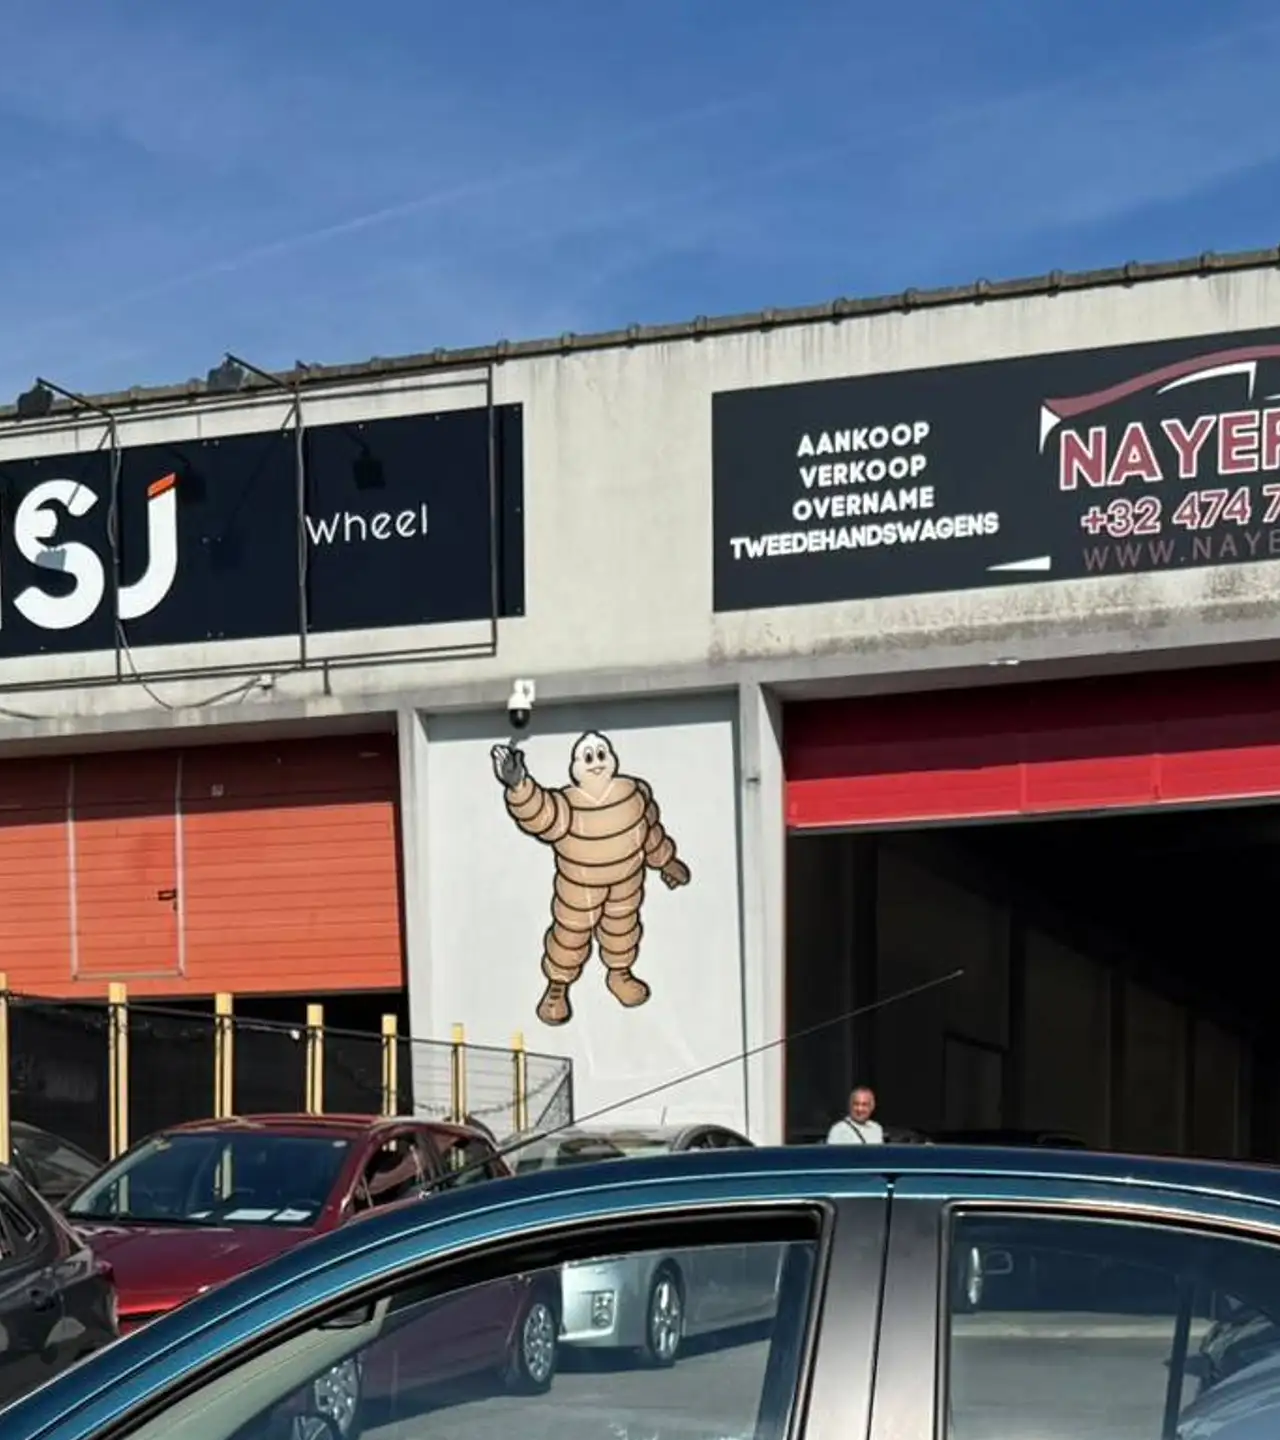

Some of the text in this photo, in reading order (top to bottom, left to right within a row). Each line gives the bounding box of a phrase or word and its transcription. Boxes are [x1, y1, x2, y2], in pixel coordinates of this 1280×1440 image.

[796, 420, 930, 458] AANKOOP
[798, 454, 927, 489] VERKOOP
[791, 485, 935, 521] OVERNAME
[1080, 496, 1161, 538] +32
[1172, 486, 1250, 530] 474
[729, 511, 1000, 560] TWEEDEHANDSWAGENS
